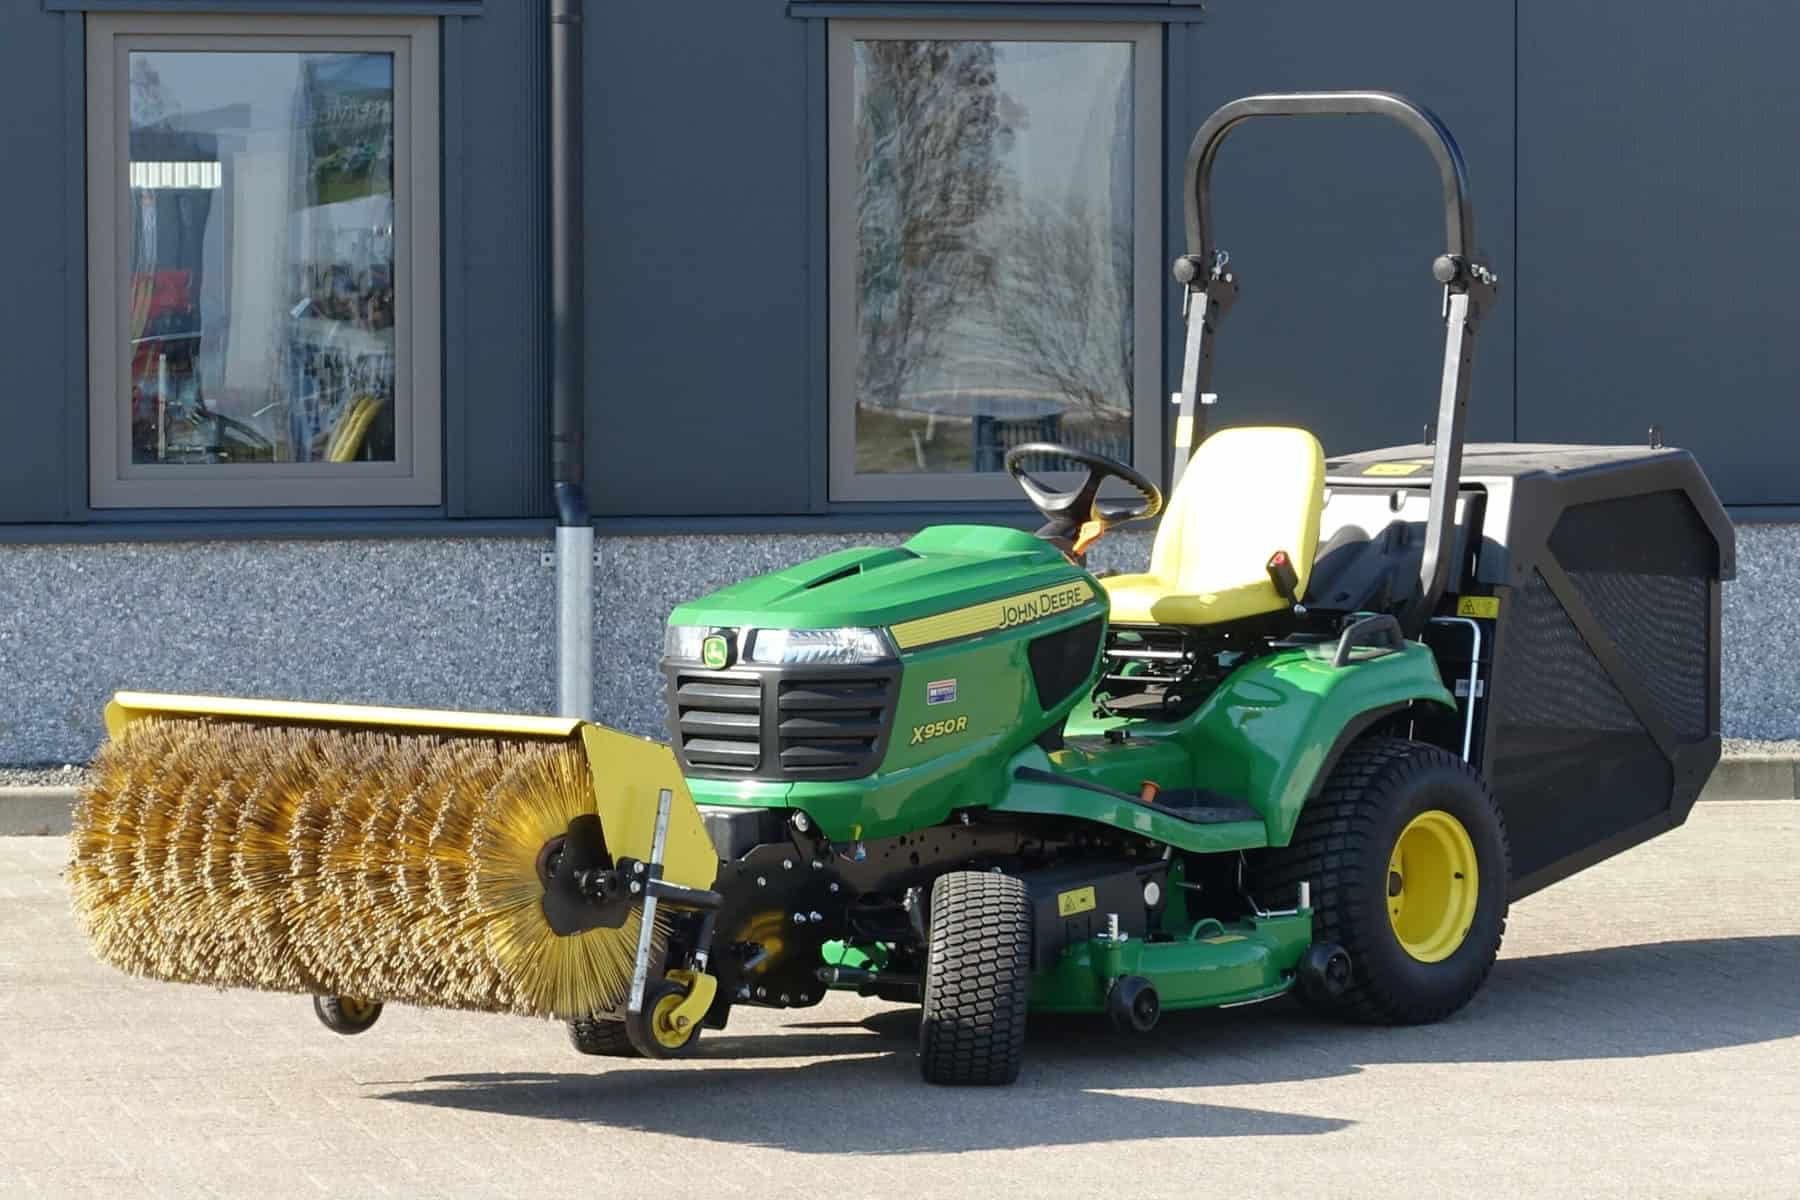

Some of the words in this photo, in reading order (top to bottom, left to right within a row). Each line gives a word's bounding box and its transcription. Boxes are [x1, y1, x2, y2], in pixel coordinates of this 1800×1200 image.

[999, 599, 1038, 627] JOHN
[1040, 586, 1081, 614] DEERE
[910, 715, 968, 745] X950R
